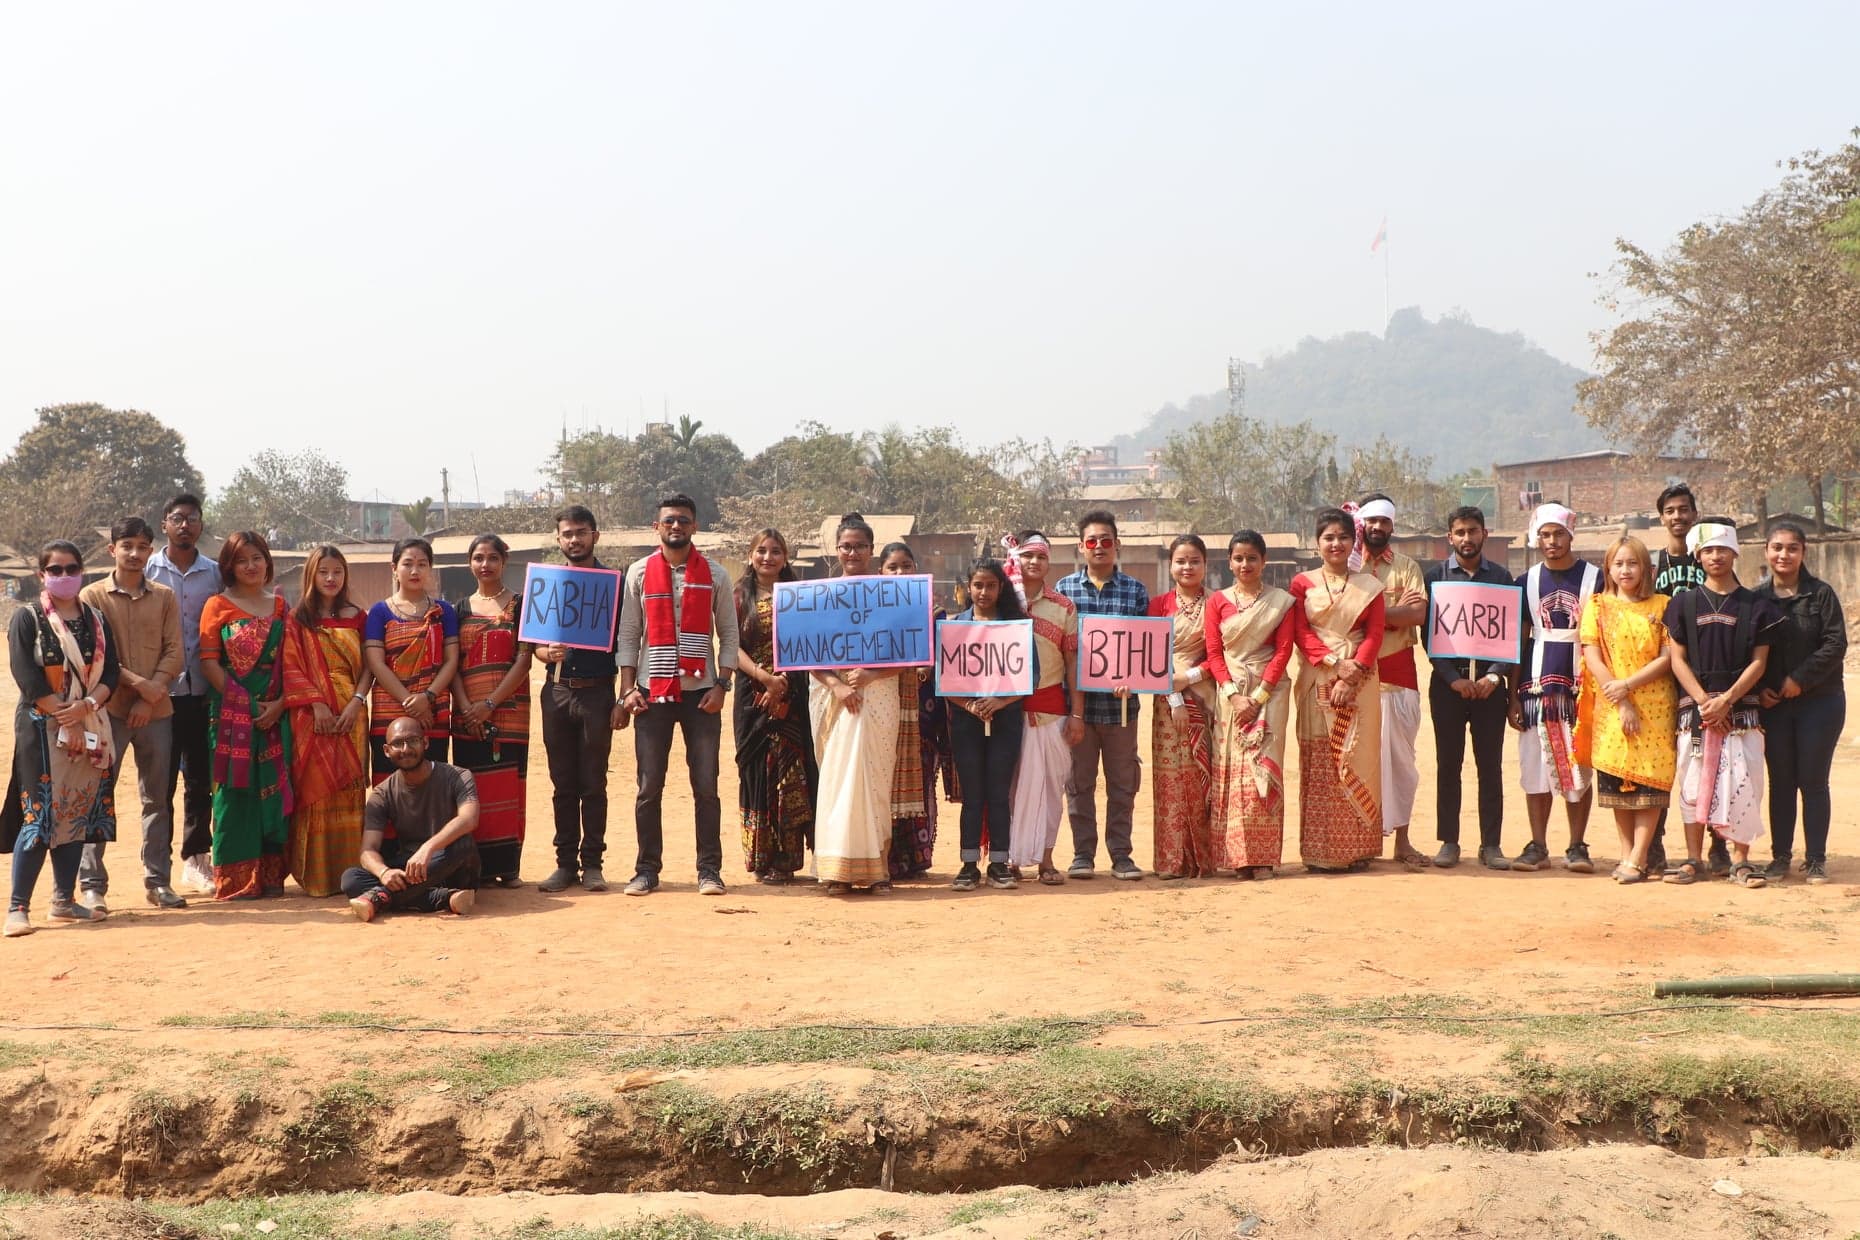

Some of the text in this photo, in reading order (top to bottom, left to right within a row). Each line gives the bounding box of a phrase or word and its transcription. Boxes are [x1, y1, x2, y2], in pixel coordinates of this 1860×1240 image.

[526, 578, 612, 630] RABHA
[778, 579, 928, 612] DEPARTMENT
[851, 609, 870, 624] OF
[1434, 603, 1507, 640] KARBI
[778, 629, 924, 663] MANAGEMENT
[941, 642, 1024, 676] MISING
[1088, 630, 1170, 680] BIHU
